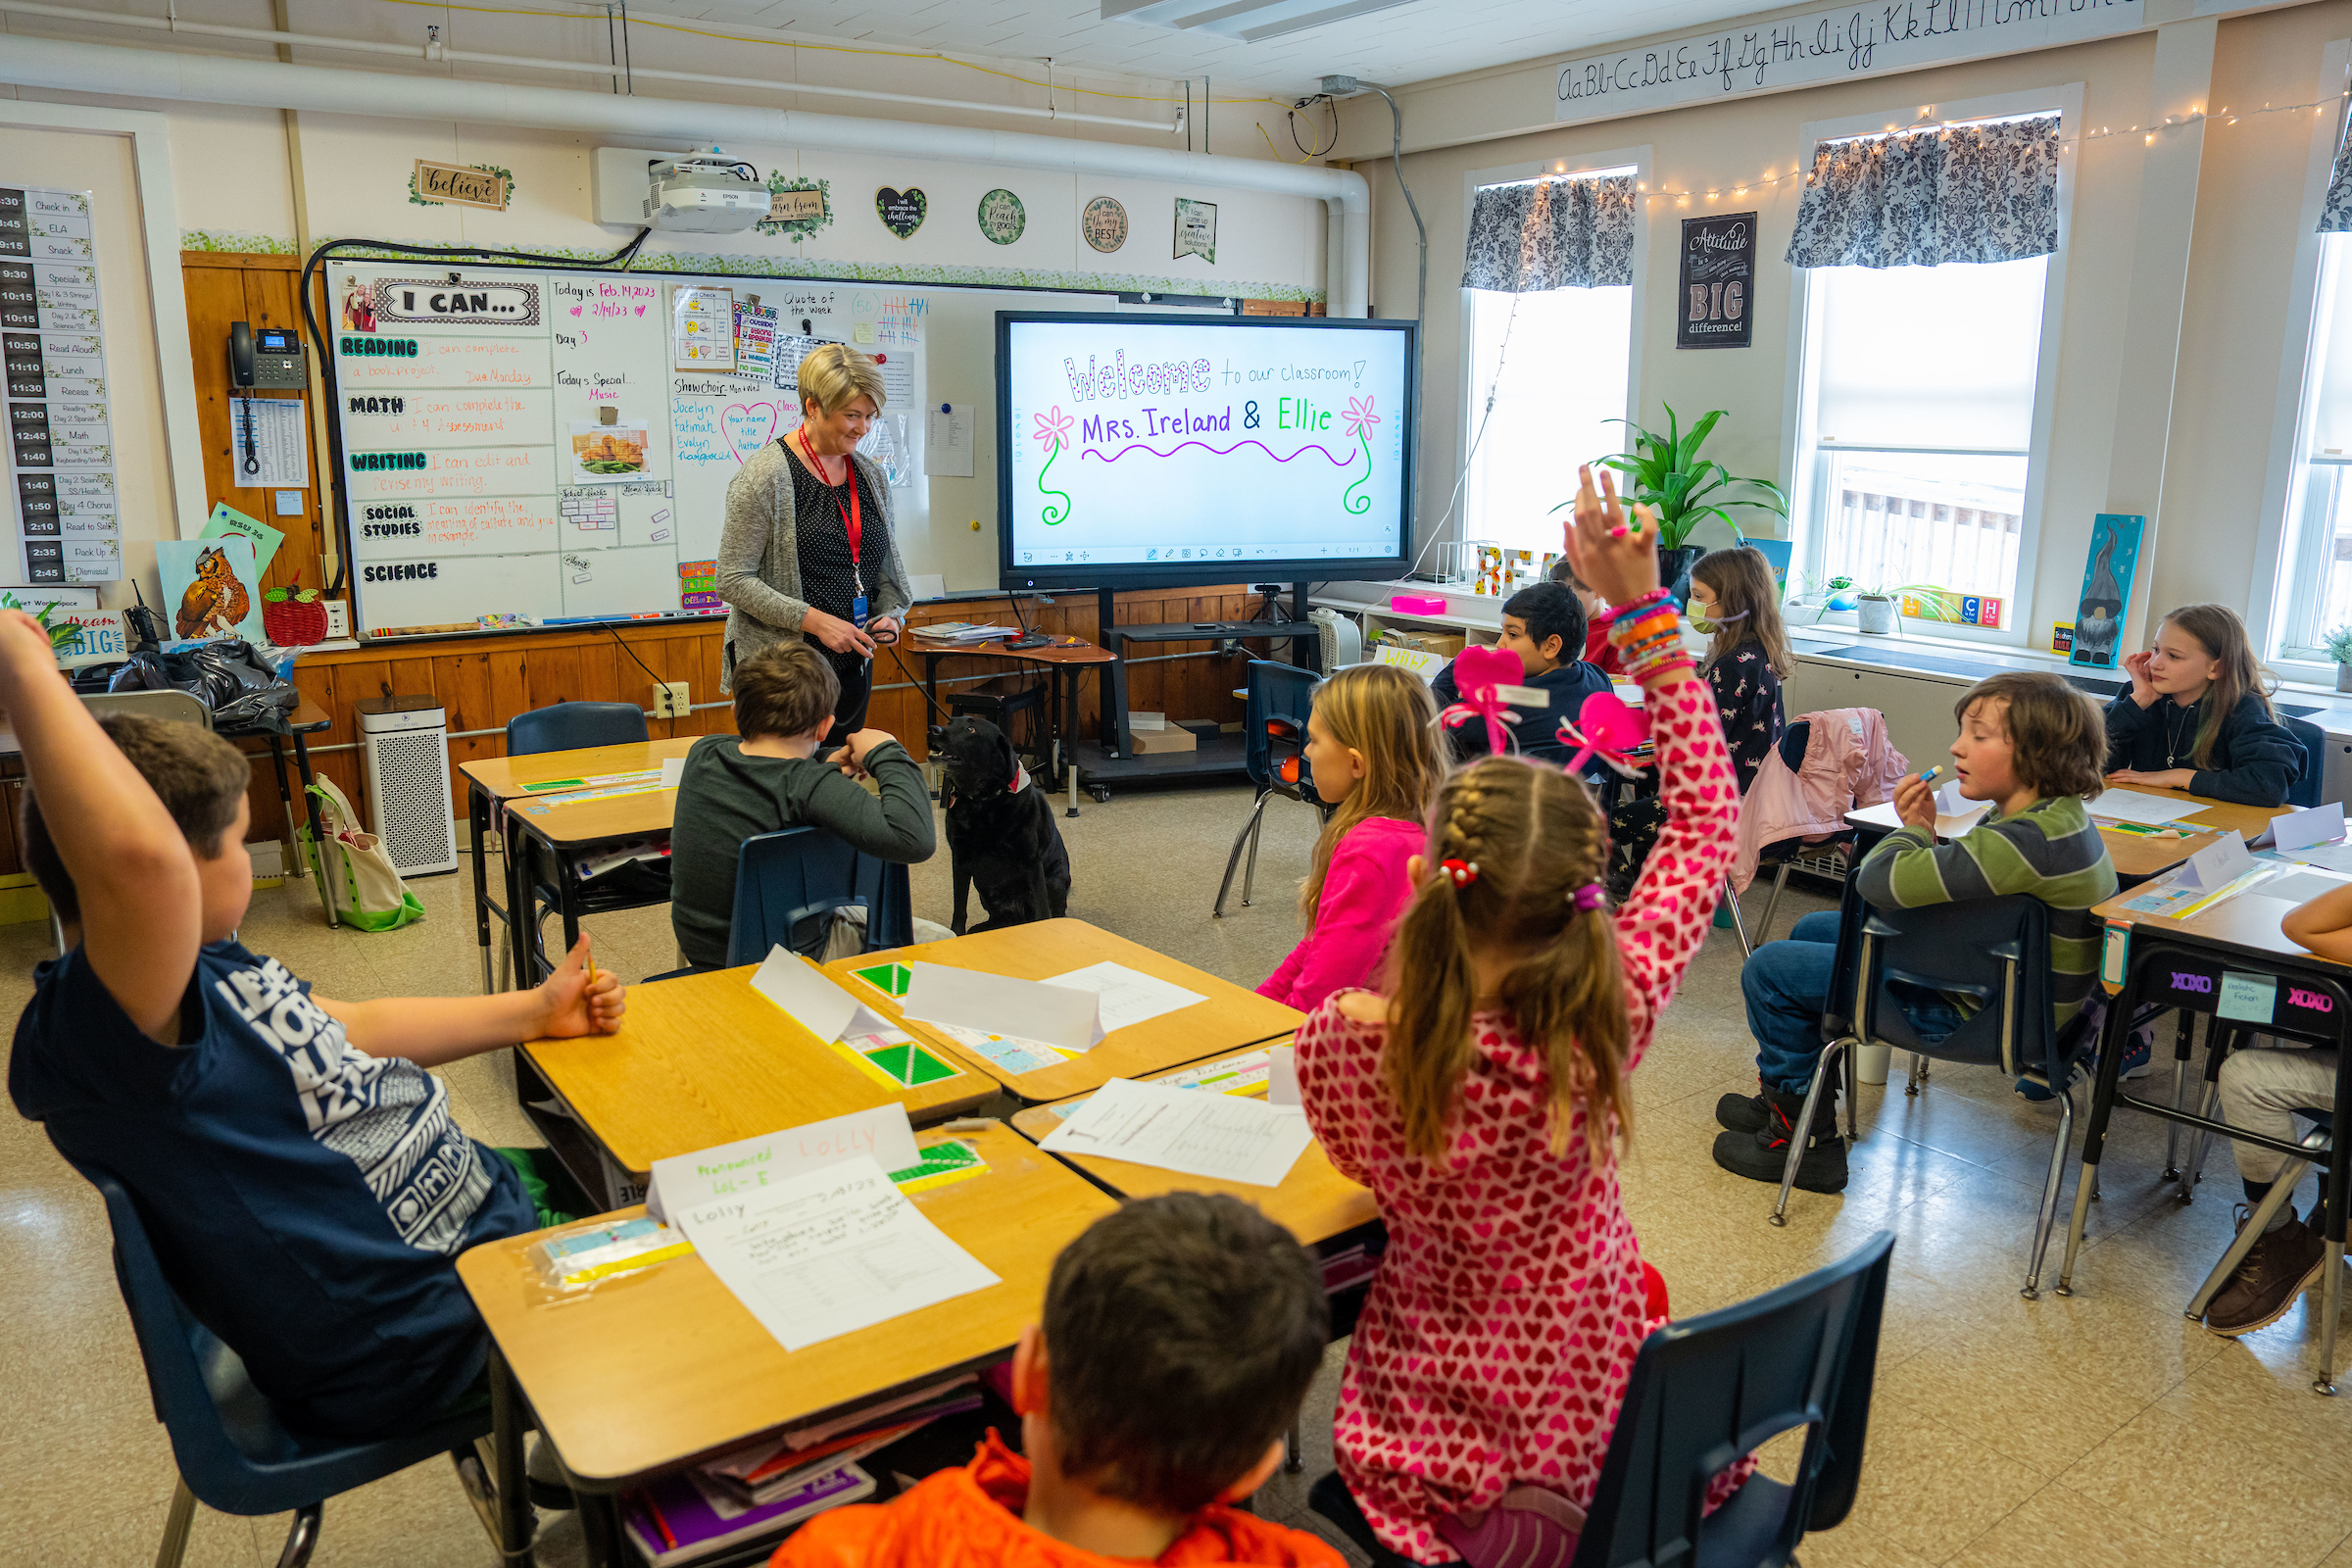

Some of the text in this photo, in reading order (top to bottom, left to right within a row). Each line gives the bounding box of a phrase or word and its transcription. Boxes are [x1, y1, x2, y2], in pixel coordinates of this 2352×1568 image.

[429, 170, 495, 199] believe
[35, 200, 72, 214] Check in
[772, 197, 820, 213] arn from
[796, 211, 821, 220] mistakes
[887, 211, 919, 223] challenge
[49, 223, 69, 234] ELA
[996, 220, 1016, 232] goals
[1095, 228, 1117, 240] BEST
[1180, 228, 1212, 241] creative
[1689, 221, 1748, 254] Attitude
[1184, 239, 1207, 248] solutions
[48, 244, 74, 257] Snack
[2, 270, 28, 280] 9:30
[48, 272, 81, 286] Specials
[2, 291, 34, 303] 10:15
[553, 281, 583, 303] Today
[585, 284, 595, 298] is
[599, 282, 620, 298] Feb.
[784, 291, 835, 305] Quote of
[402, 291, 516, 314] I CAN...
[1689, 280, 1743, 321] BIG
[591, 300, 628, 322] 2/14/23
[790, 305, 806, 317] the
[5, 314, 36, 324] 10:15
[1689, 320, 1742, 334] difference!
[7, 340, 38, 351] 10:50
[556, 329, 588, 350] Day 3
[49, 343, 93, 354] Read Aloud
[341, 338, 417, 356] READING
[423, 341, 519, 357] I can complete
[9, 363, 40, 372] 11:10
[61, 365, 85, 375] Lunch
[353, 363, 440, 379] a book project.
[465, 368, 531, 386] Due Monday
[1063, 348, 1368, 403] Welcome to our classroom!
[11, 383, 43, 393] 11:30
[61, 386, 90, 397] Recess
[588, 388, 619, 401] Music
[62, 404, 86, 414] Reading
[350, 397, 404, 414] MATH
[411, 396, 526, 416] I can complete the
[672, 397, 714, 420] Jocelyn
[776, 399, 799, 413] Class
[14, 411, 45, 420] 12:00
[74, 415, 97, 423] Spanish
[1142, 405, 1231, 437] Ireland
[1244, 400, 1261, 430] &
[1278, 397, 1333, 432] Ellie
[421, 418, 430, 433] 4
[674, 416, 717, 434] Fatimah
[16, 432, 47, 441] 12:45
[69, 430, 90, 441] Math
[741, 427, 757, 437] title
[676, 435, 710, 455] Evelyn
[738, 438, 761, 451] Author
[22, 453, 47, 462] 1:40
[351, 453, 427, 470] WRITING
[428, 452, 531, 470] I can edit and
[25, 481, 50, 491] 1:40
[58, 475, 73, 486] Day
[372, 472, 488, 494] revise my writing.
[27, 502, 52, 512] 1:50
[76, 501, 84, 510] 4
[86, 500, 113, 510] Chorus
[425, 500, 524, 519] I can identify the
[366, 506, 416, 520] SOCIAL
[30, 522, 55, 532] 2:10
[66, 521, 85, 531] Read
[87, 522, 95, 531] to
[229, 518, 265, 540] RSU 26
[363, 521, 421, 537] STUDIES
[426, 513, 535, 534] meaning of culture and
[32, 548, 57, 558] 2:35
[74, 548, 107, 559] Pack Up
[34, 568, 59, 578] 2:45
[75, 566, 110, 576] Dismissal
[363, 562, 439, 583] SCIENCE
[684, 579, 702, 589] Hall
[57, 600, 78, 609] Space
[684, 596, 706, 605] Office
[1965, 599, 1977, 612] C
[1985, 601, 1997, 615] H
[62, 614, 121, 629] dream
[73, 629, 114, 656] BIG
[2170, 970, 2213, 995] XOXO
[2286, 986, 2334, 1013] XOXO
